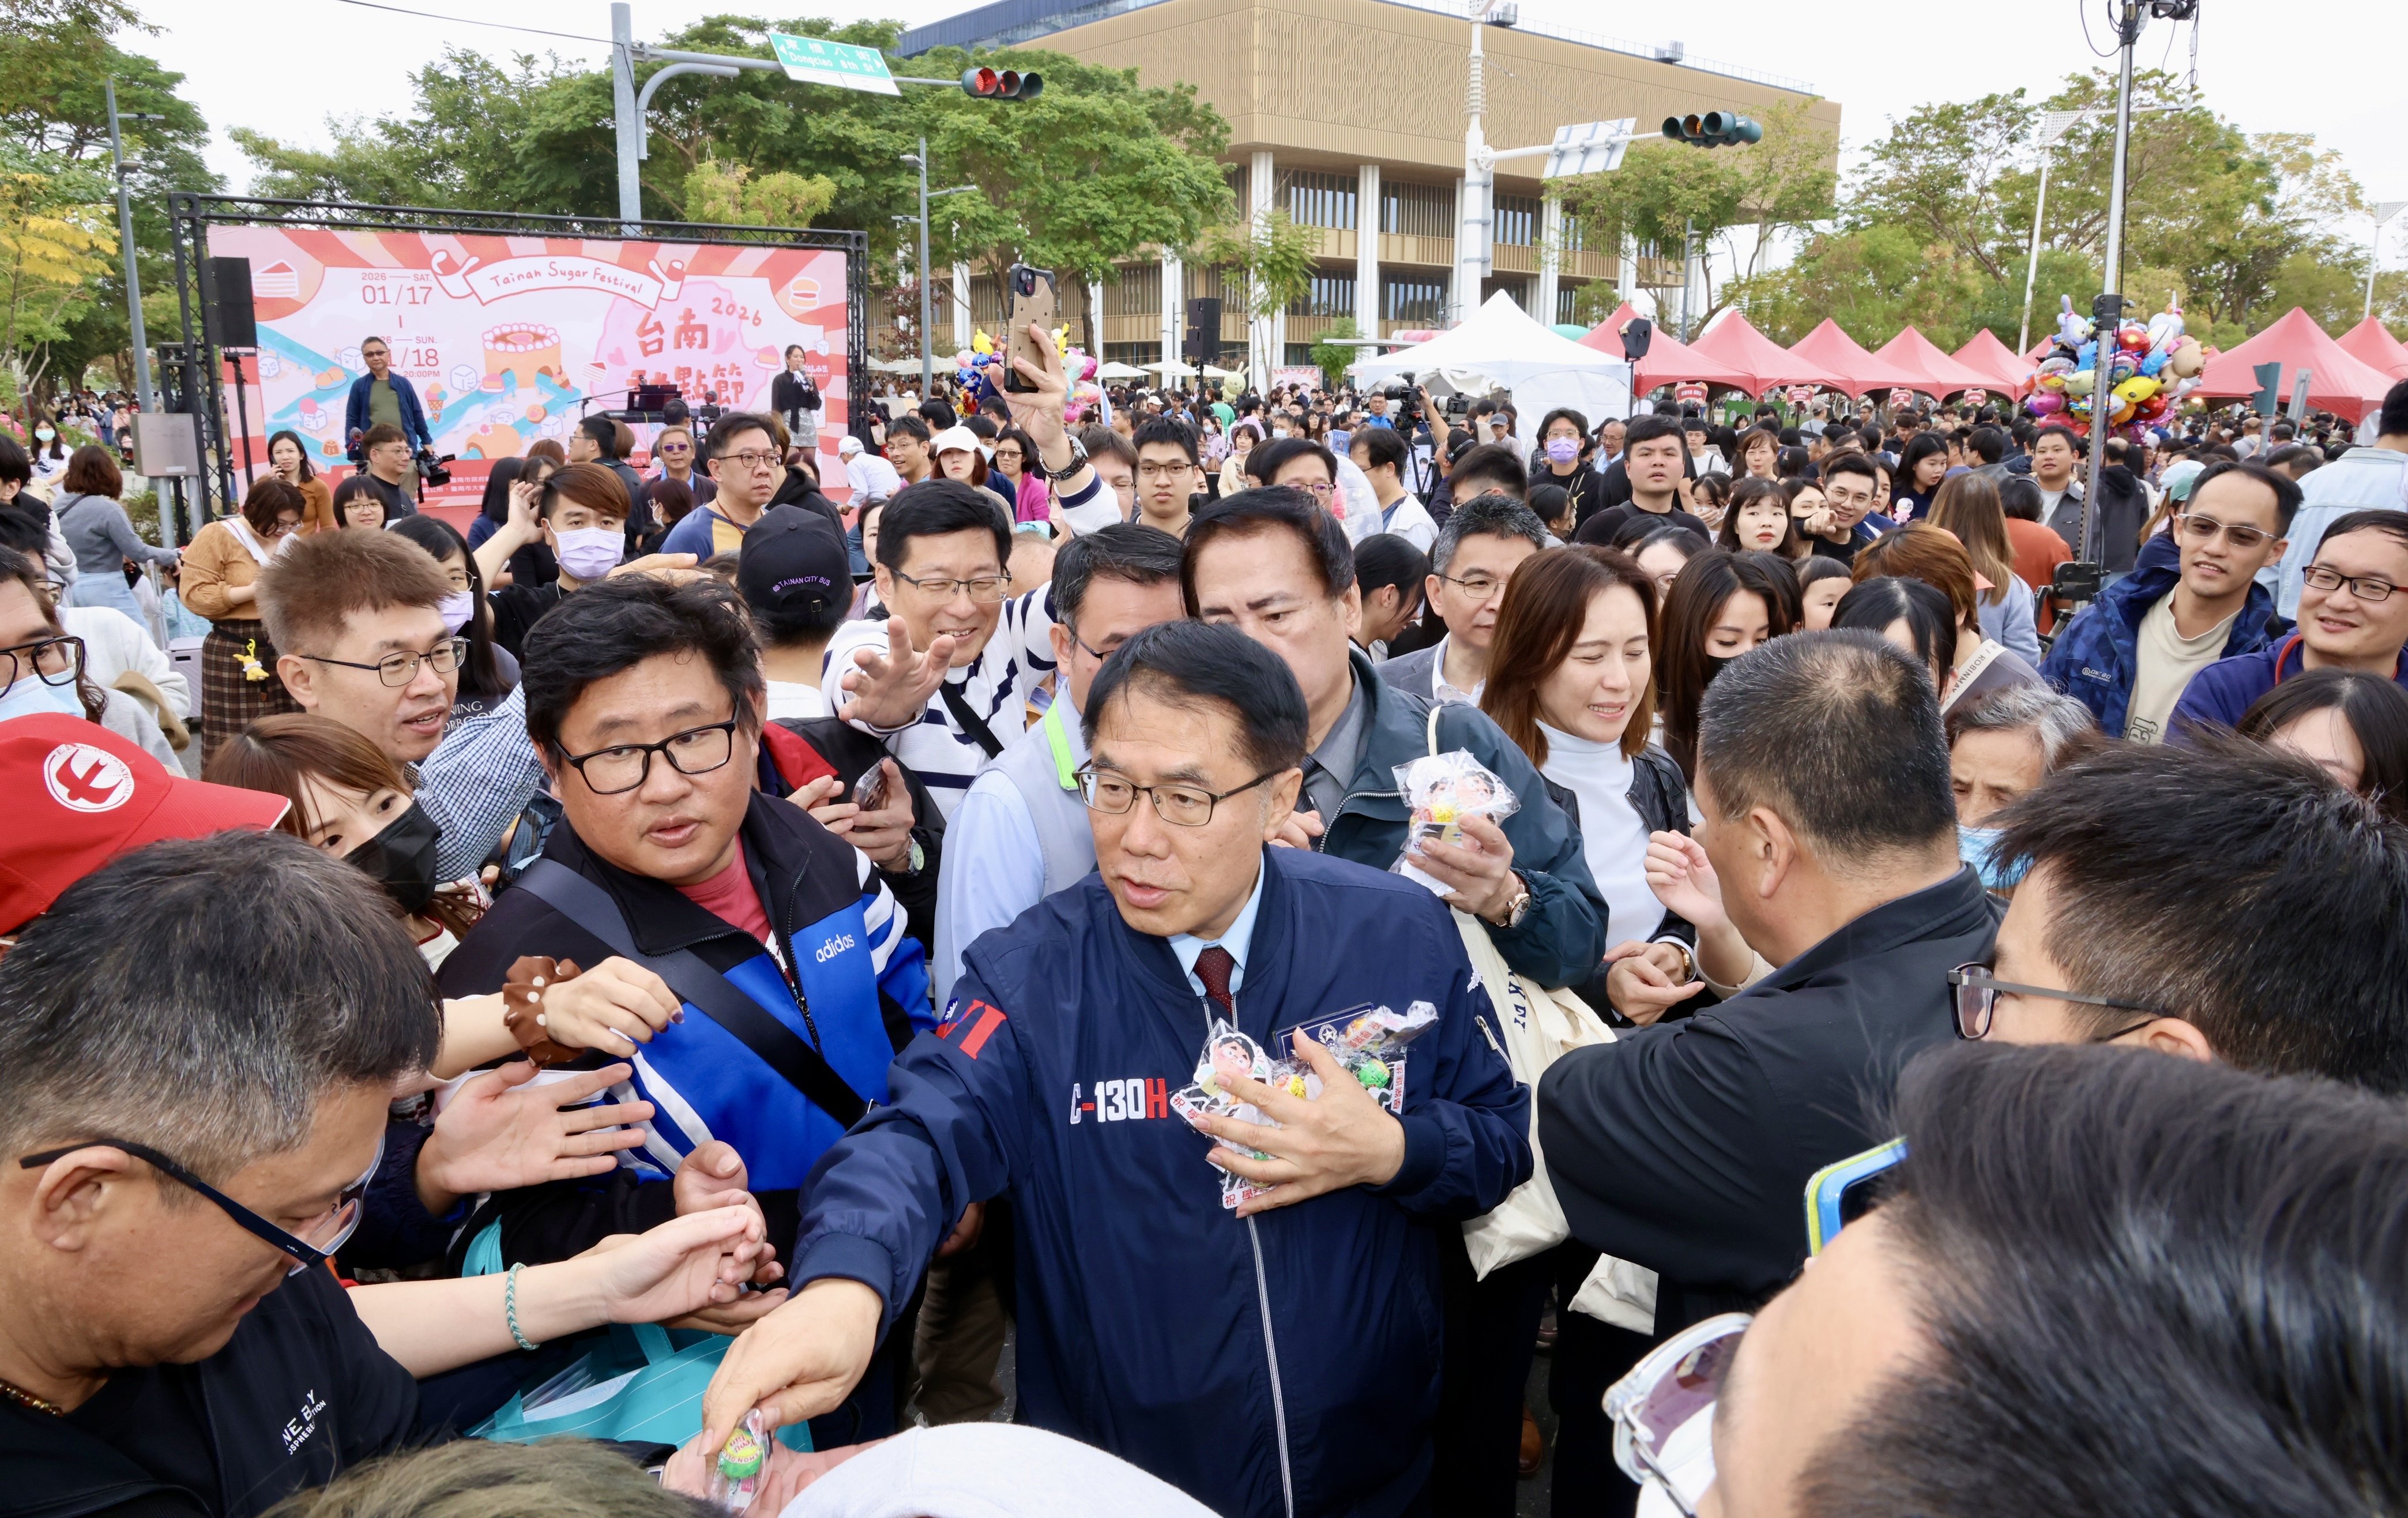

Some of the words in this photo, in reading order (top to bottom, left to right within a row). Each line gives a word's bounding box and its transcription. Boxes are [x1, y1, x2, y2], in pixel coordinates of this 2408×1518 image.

[784, 38, 870, 61] 東橋八街
[788, 52, 833, 67] Dongciao
[840, 59, 859, 71] 8th
[863, 63, 878, 73] St.
[490, 269, 541, 287] Tainan
[548, 261, 588, 281] Sugar
[593, 267, 643, 294] Festival
[362, 284, 432, 305] 01/17
[712, 297, 762, 326] 2026
[635, 307, 708, 358] 台南
[387, 347, 439, 368] 1/18
[778, 577, 803, 587] TAINAN
[819, 577, 830, 586] BUS
[816, 934, 855, 963] adidas
[1070, 1078, 1168, 1125] C-130H
[282, 1417, 303, 1445] NE
